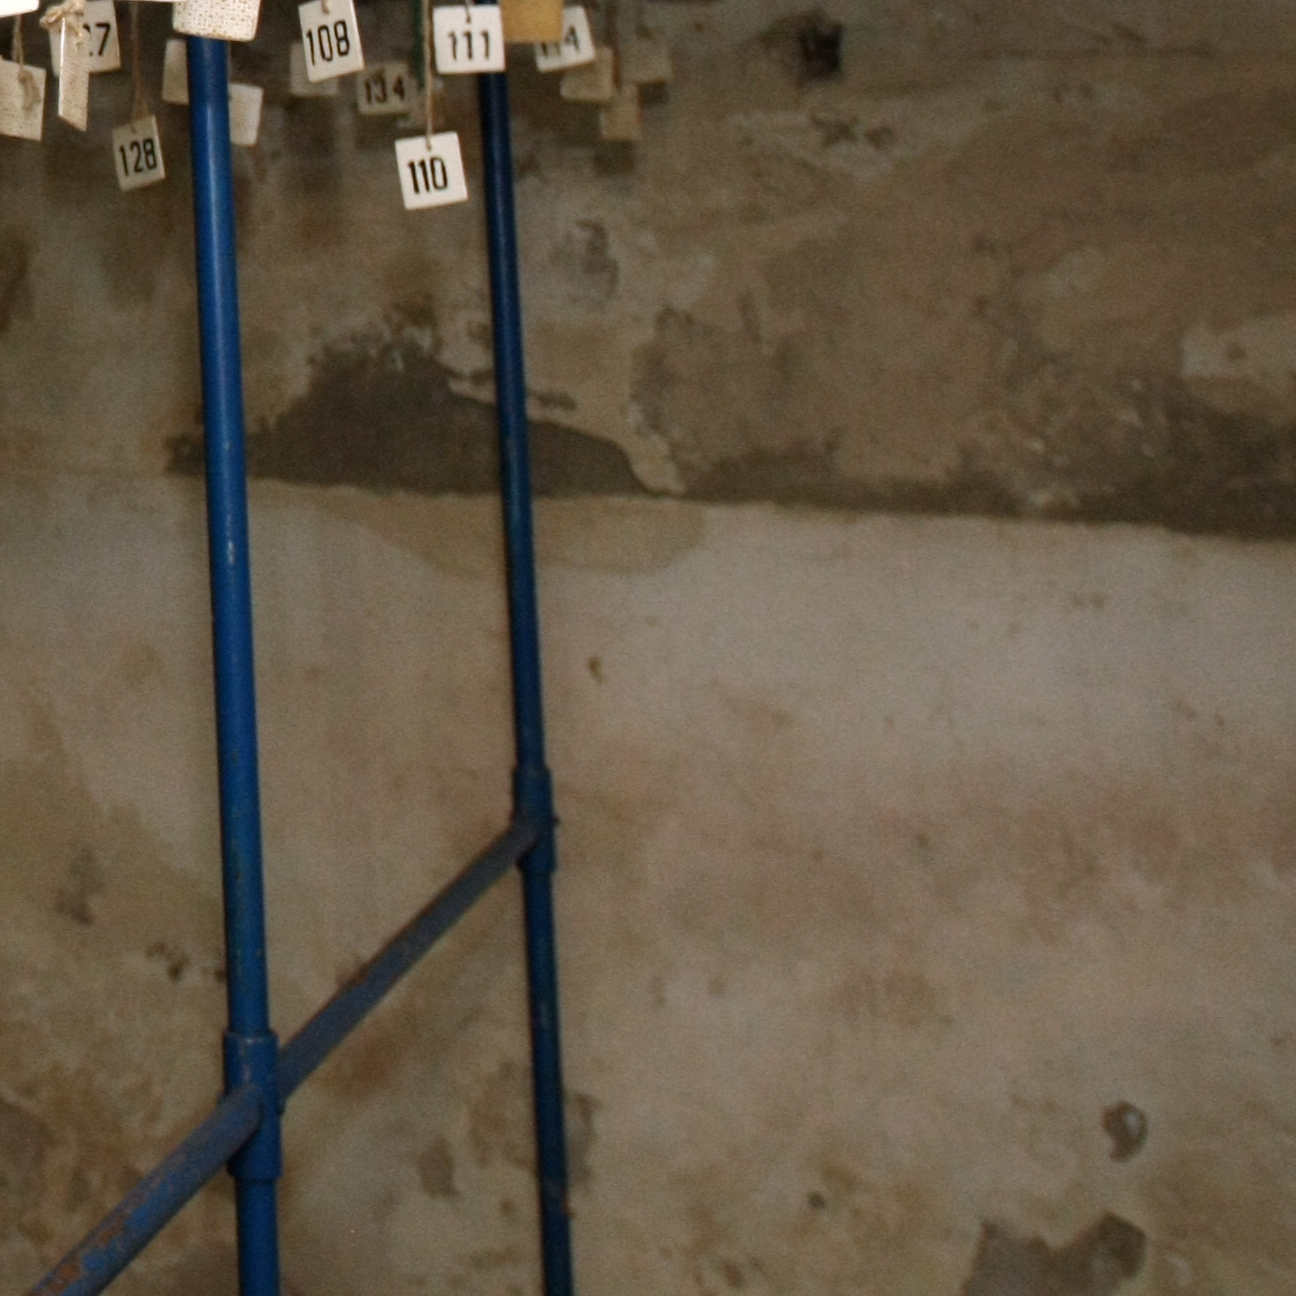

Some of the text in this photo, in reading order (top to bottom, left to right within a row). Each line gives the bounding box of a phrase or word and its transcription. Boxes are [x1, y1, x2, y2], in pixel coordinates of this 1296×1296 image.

[306, 20, 351, 66] 108
[448, 31, 490, 61] 111
[118, 138, 158, 177] 128
[407, 156, 449, 195] 110
